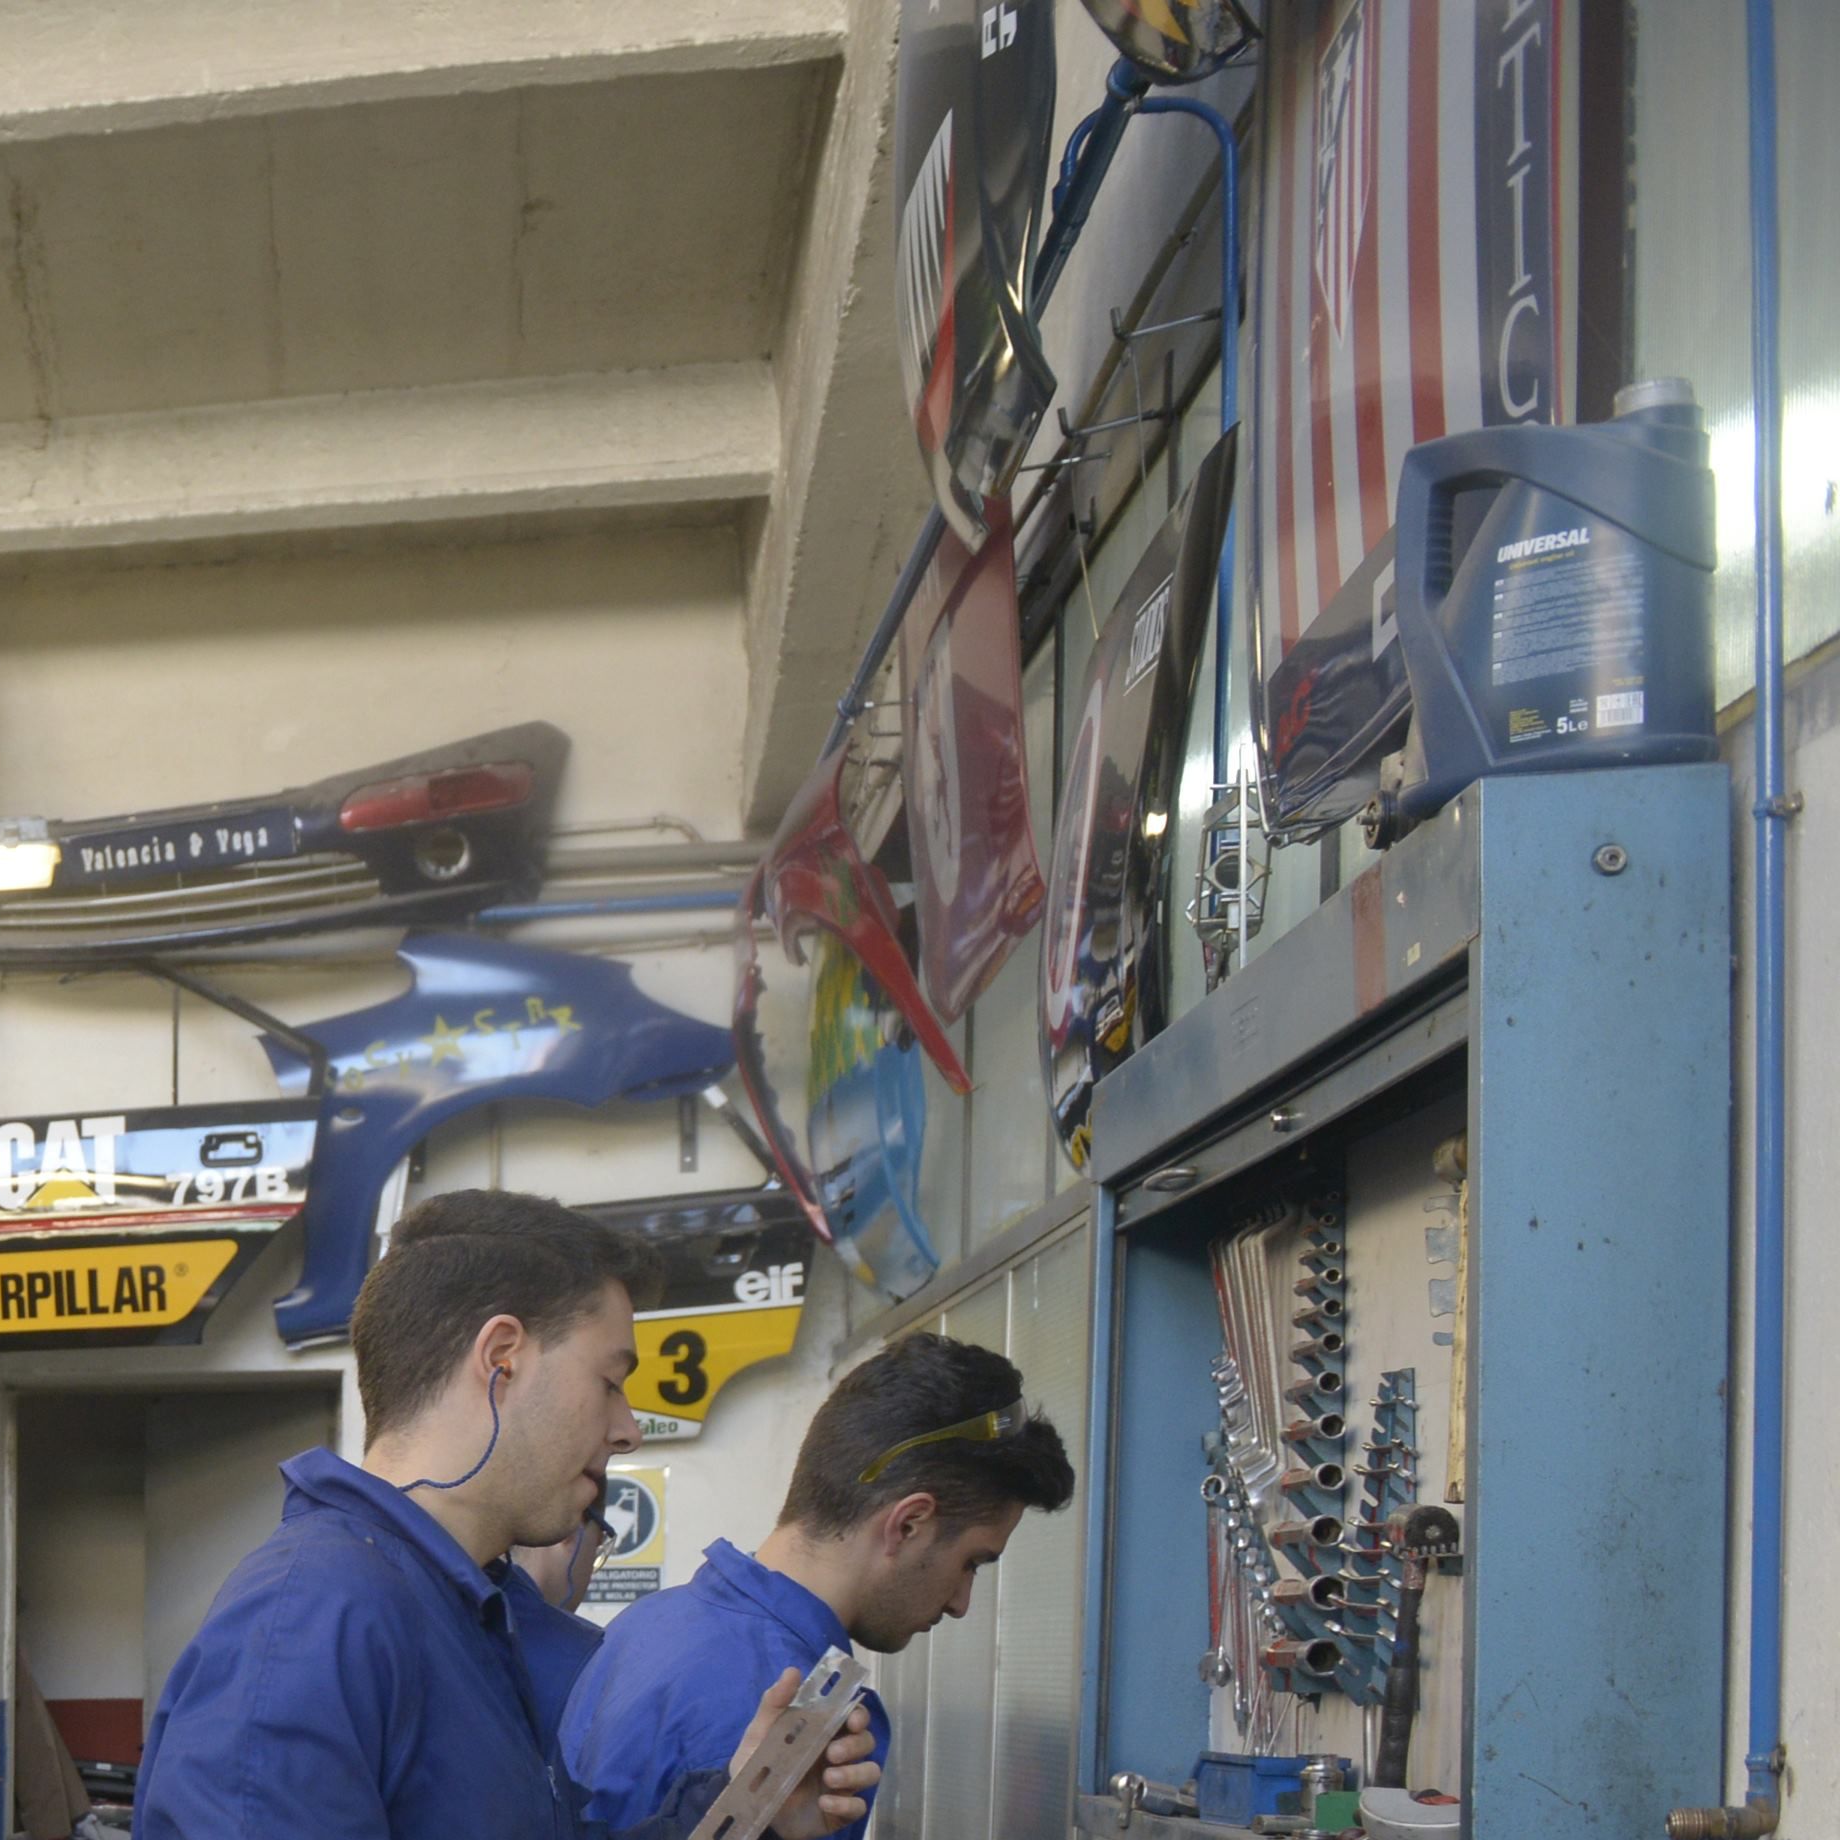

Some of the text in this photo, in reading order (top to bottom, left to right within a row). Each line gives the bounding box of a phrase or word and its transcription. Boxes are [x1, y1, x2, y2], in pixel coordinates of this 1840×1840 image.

[1496, 527, 1591, 564] UNIVERSAL
[80, 839, 176, 874] Valencia
[215, 826, 270, 859] Vega
[165, 1166, 291, 1206] 797B
[733, 1262, 805, 1302] elf
[657, 1329, 709, 1406] 3
[635, 1417, 679, 1436] aleo
